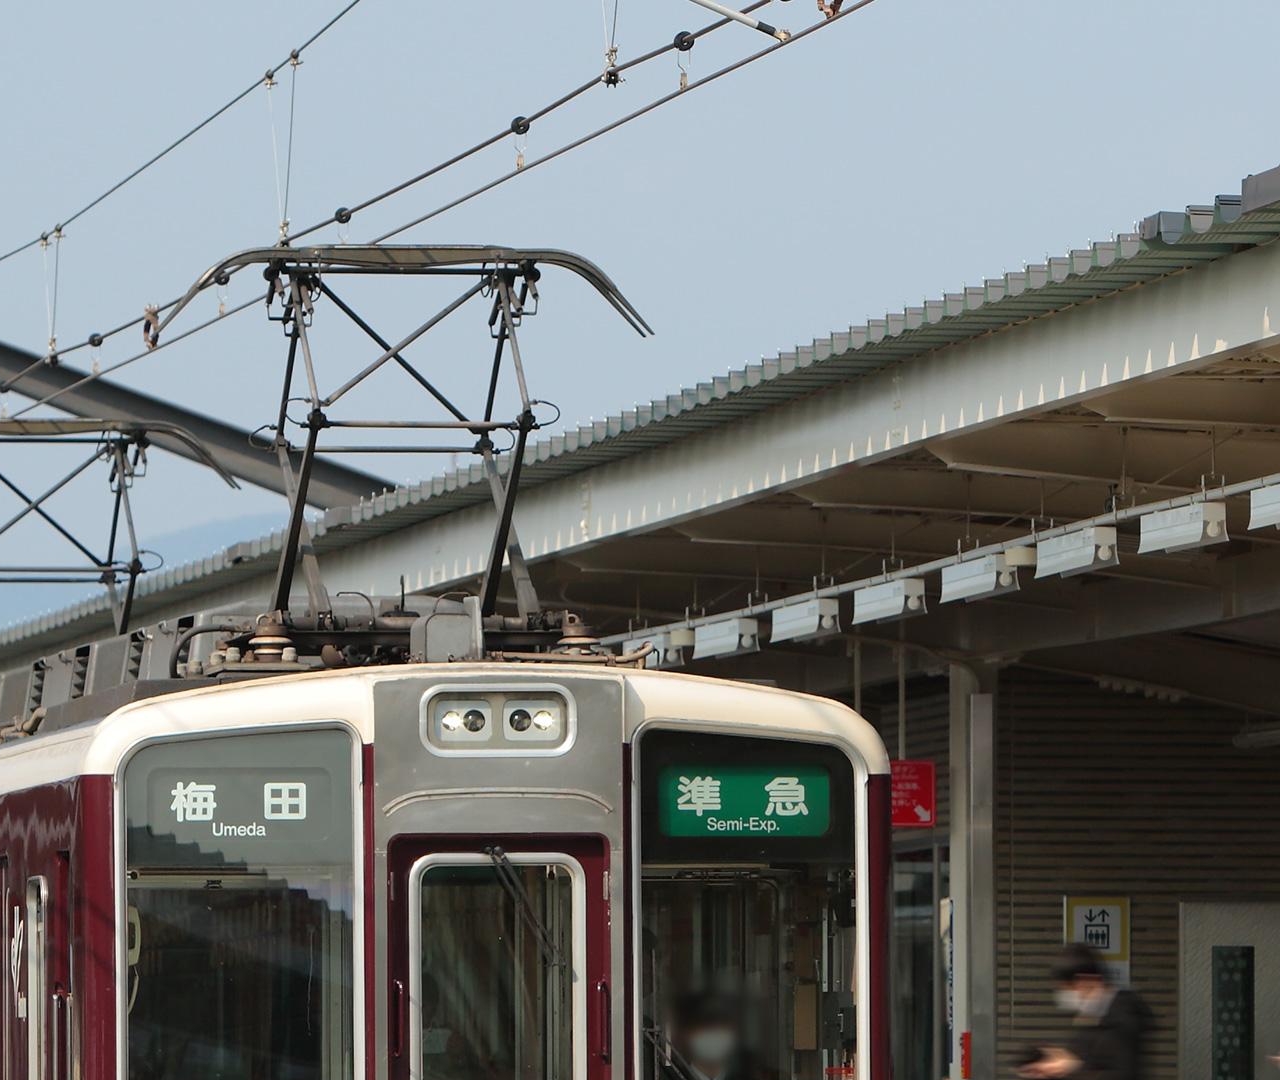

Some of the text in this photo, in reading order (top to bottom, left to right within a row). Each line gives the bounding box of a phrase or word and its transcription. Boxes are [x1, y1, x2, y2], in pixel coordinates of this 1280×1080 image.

[170, 781, 307, 823] 梅田
[677, 775, 809, 817] 準急
[212, 822, 266, 837] Umeda
[707, 817, 780, 832] Semi-Exp.
